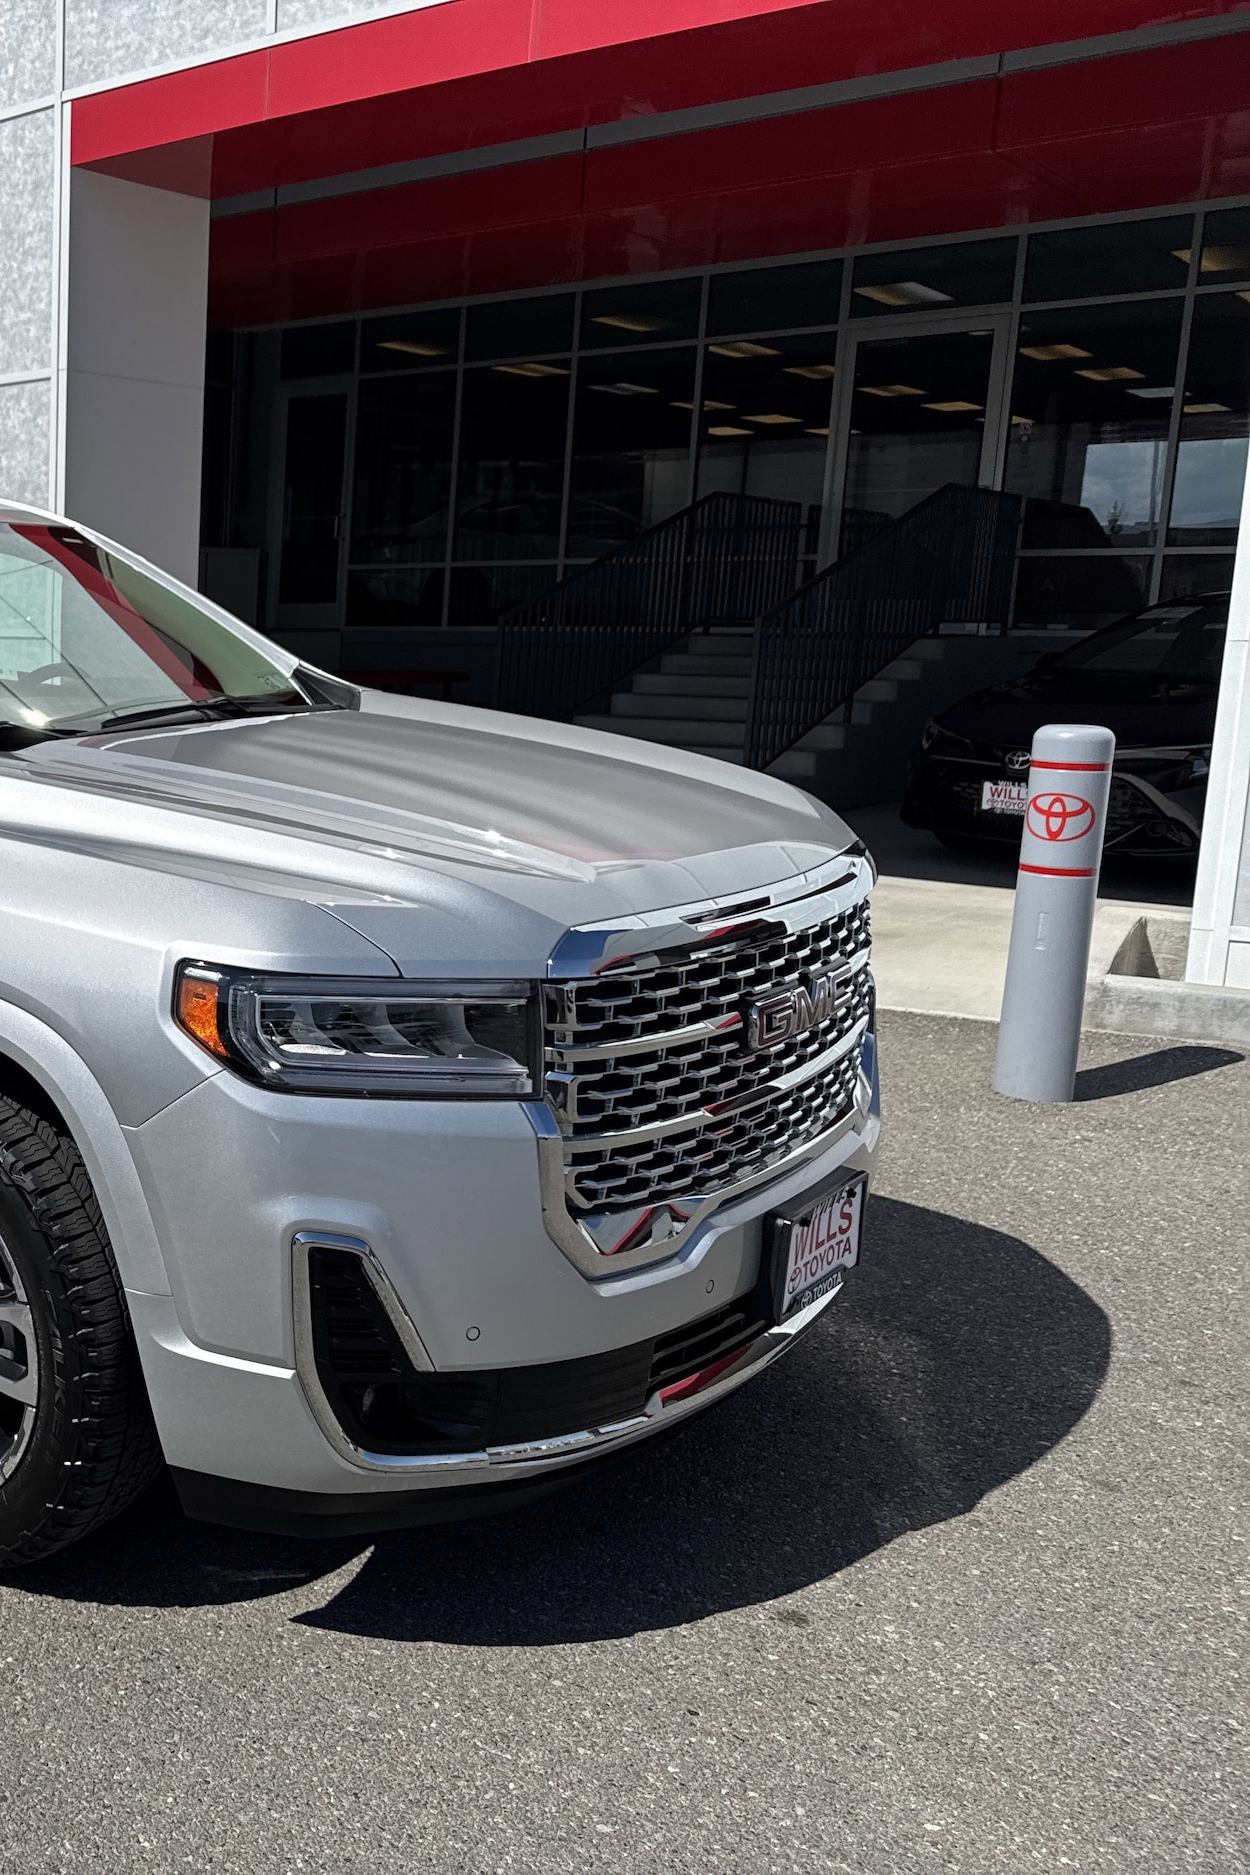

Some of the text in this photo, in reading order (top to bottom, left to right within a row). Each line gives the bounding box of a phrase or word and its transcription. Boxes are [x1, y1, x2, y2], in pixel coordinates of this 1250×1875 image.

[990, 786, 1028, 801] WILL
[1000, 800, 1026, 809] TOYO
[750, 963, 852, 1051] GMC
[794, 1197, 853, 1266] WILLS
[803, 1236, 852, 1282] TOYOTA
[813, 1271, 842, 1301] TOYOTA
